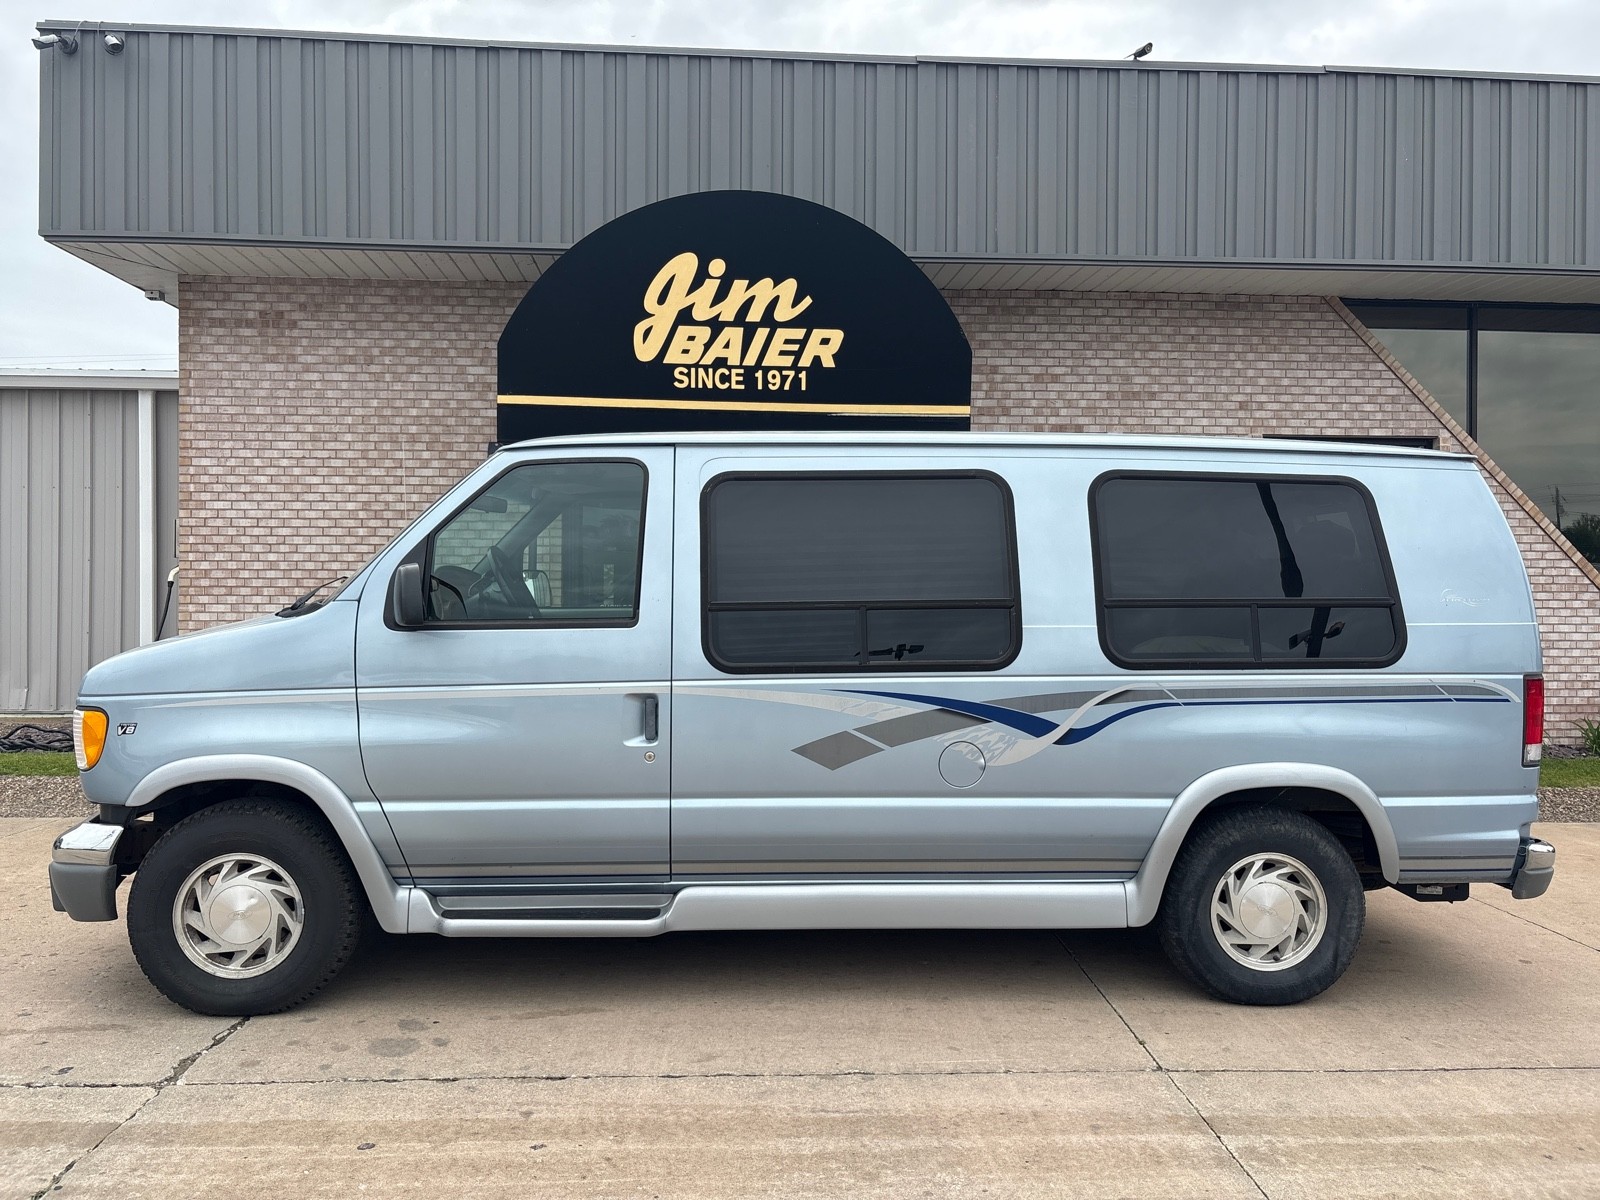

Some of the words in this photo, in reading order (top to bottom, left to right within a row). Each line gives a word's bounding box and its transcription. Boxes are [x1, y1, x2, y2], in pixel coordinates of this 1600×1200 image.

[633, 252, 813, 362] Jim
[663, 325, 844, 367] BAIER
[673, 367, 745, 389] SINCE
[754, 370, 807, 390] 1971
[117, 726, 135, 735] V8
